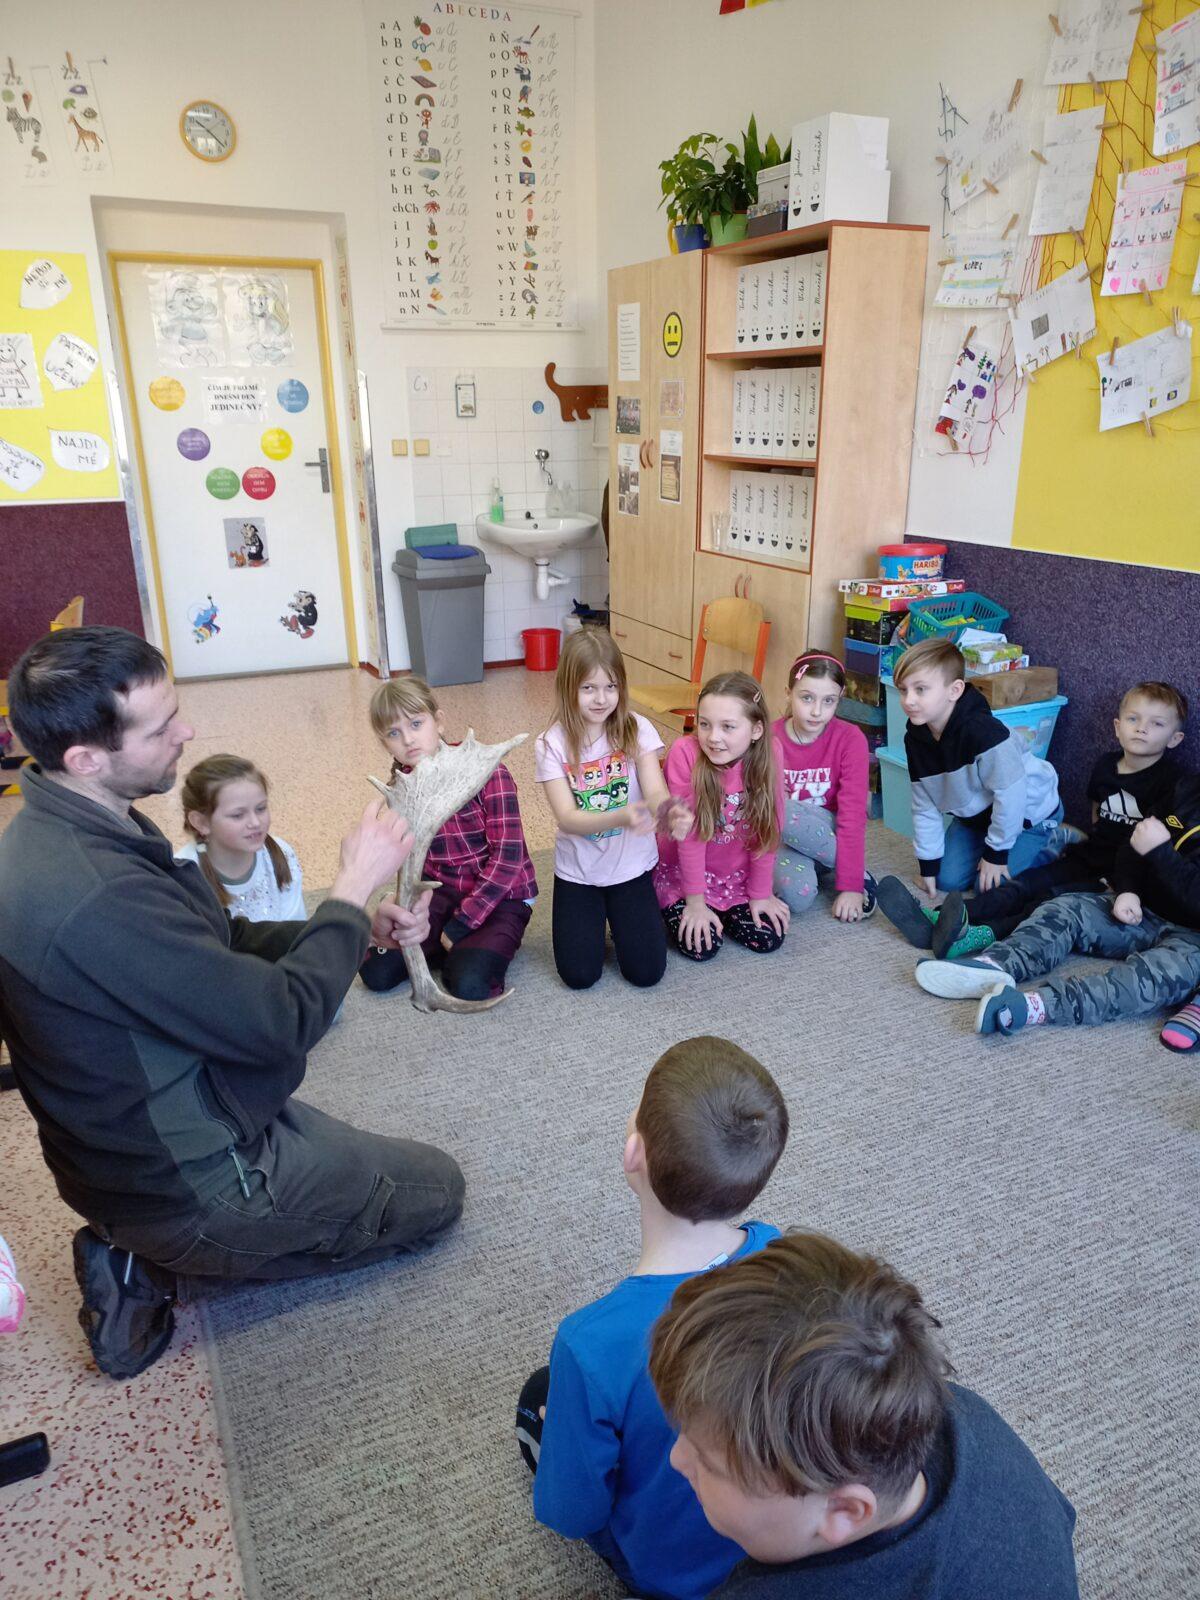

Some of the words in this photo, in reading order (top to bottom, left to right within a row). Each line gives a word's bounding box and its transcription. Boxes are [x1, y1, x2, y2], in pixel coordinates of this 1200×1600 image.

[433, 3, 511, 21] ABECEDA
[392, 20, 401, 31] A
[394, 37, 402, 49] B
[395, 55, 404, 67] C
[501, 50, 510, 61] O
[502, 67, 509, 78] P
[398, 93, 407, 105] D
[502, 87, 511, 100] Q
[503, 104, 511, 115] R
[504, 121, 511, 134] Ř
[400, 131, 408, 142] E
[504, 141, 510, 151] S
[401, 147, 408, 158] F
[505, 153, 511, 166] Š
[402, 166, 411, 177] G
[505, 173, 512, 184] T
[403, 184, 412, 195] H
[404, 202, 419, 214] Ch
[507, 208, 515, 219] U
[507, 226, 515, 236] V
[406, 237, 411, 249] J
[508, 242, 519, 252] W
[408, 256, 417, 267] K
[508, 261, 517, 271] X
[409, 272, 416, 283] L
[509, 276, 516, 286] Y
[410, 288, 420, 298] M
[510, 291, 516, 301] Z
[411, 304, 420, 314] N
[58, 435, 98, 449] NAJDI
[914, 559, 939, 568] HARIBO
[783, 767, 831, 784] EVENTY
